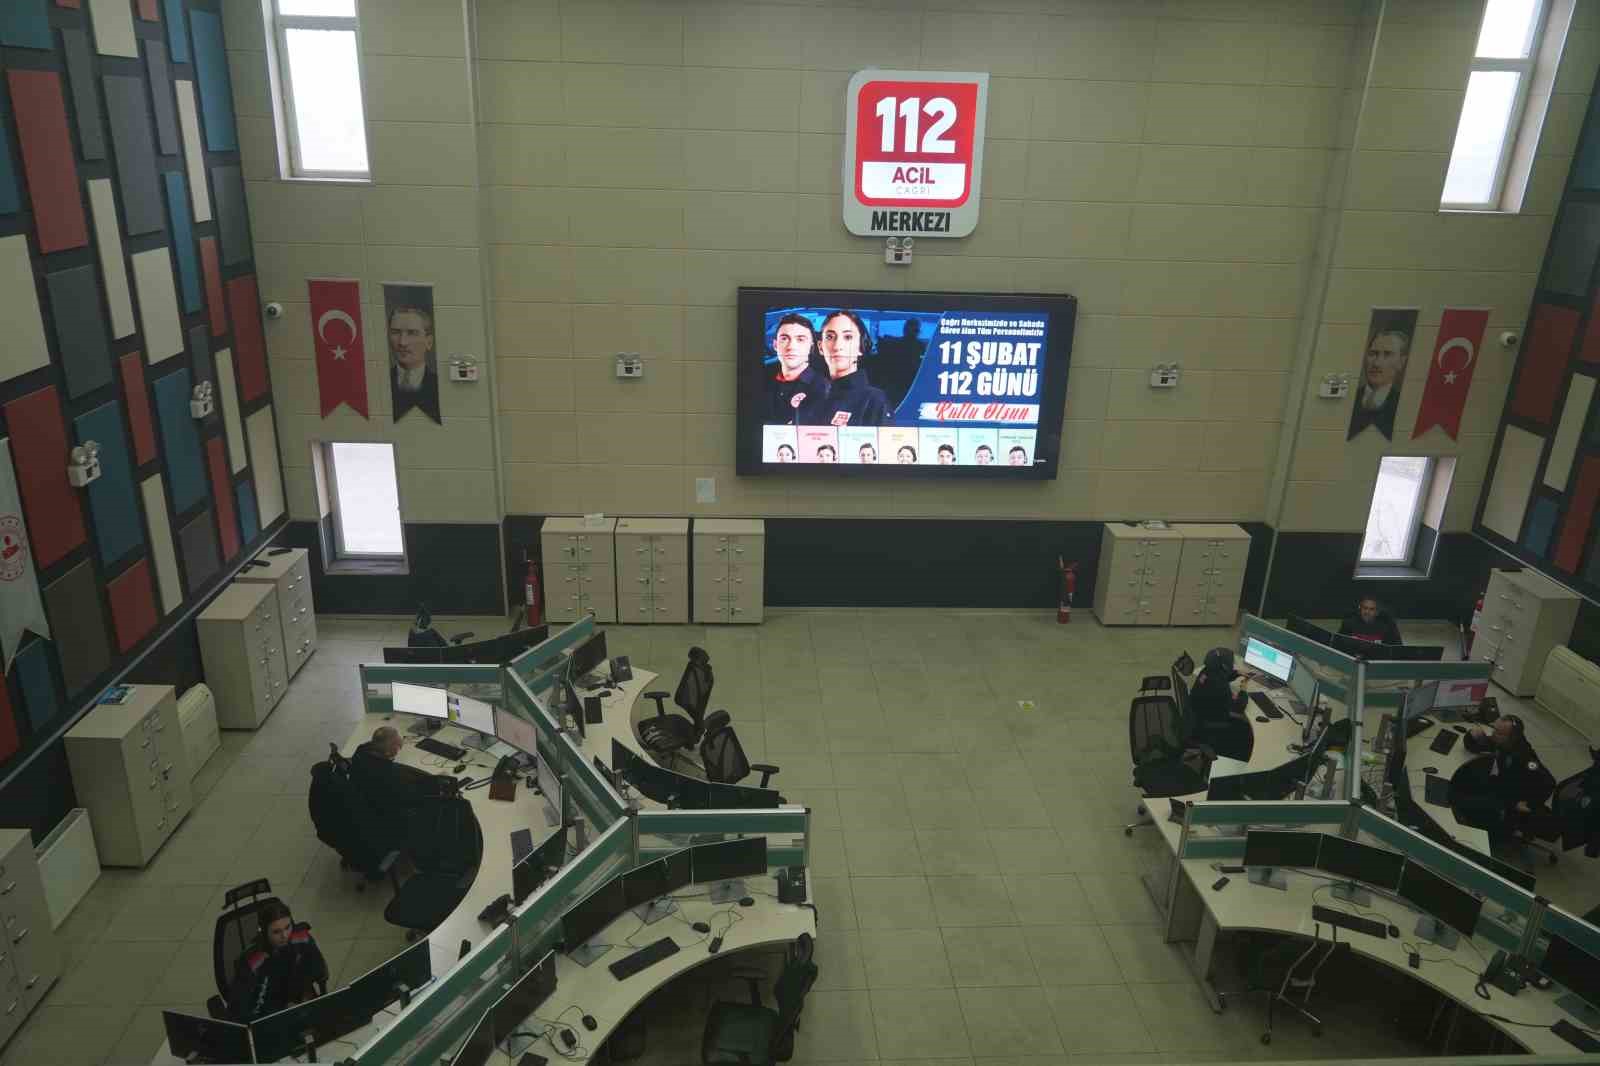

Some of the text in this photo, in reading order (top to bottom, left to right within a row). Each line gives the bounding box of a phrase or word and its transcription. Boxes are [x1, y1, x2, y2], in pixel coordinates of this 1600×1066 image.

[876, 96, 957, 153] 112
[892, 167, 936, 184] ACİL
[961, 327, 977, 335] Alan
[977, 327, 992, 336] Tüm
[939, 341, 1041, 369] 11 ŞUBAT
[937, 367, 1039, 397] 112 GÜNÜ
[935, 400, 1029, 423] Kutlu Olsun
